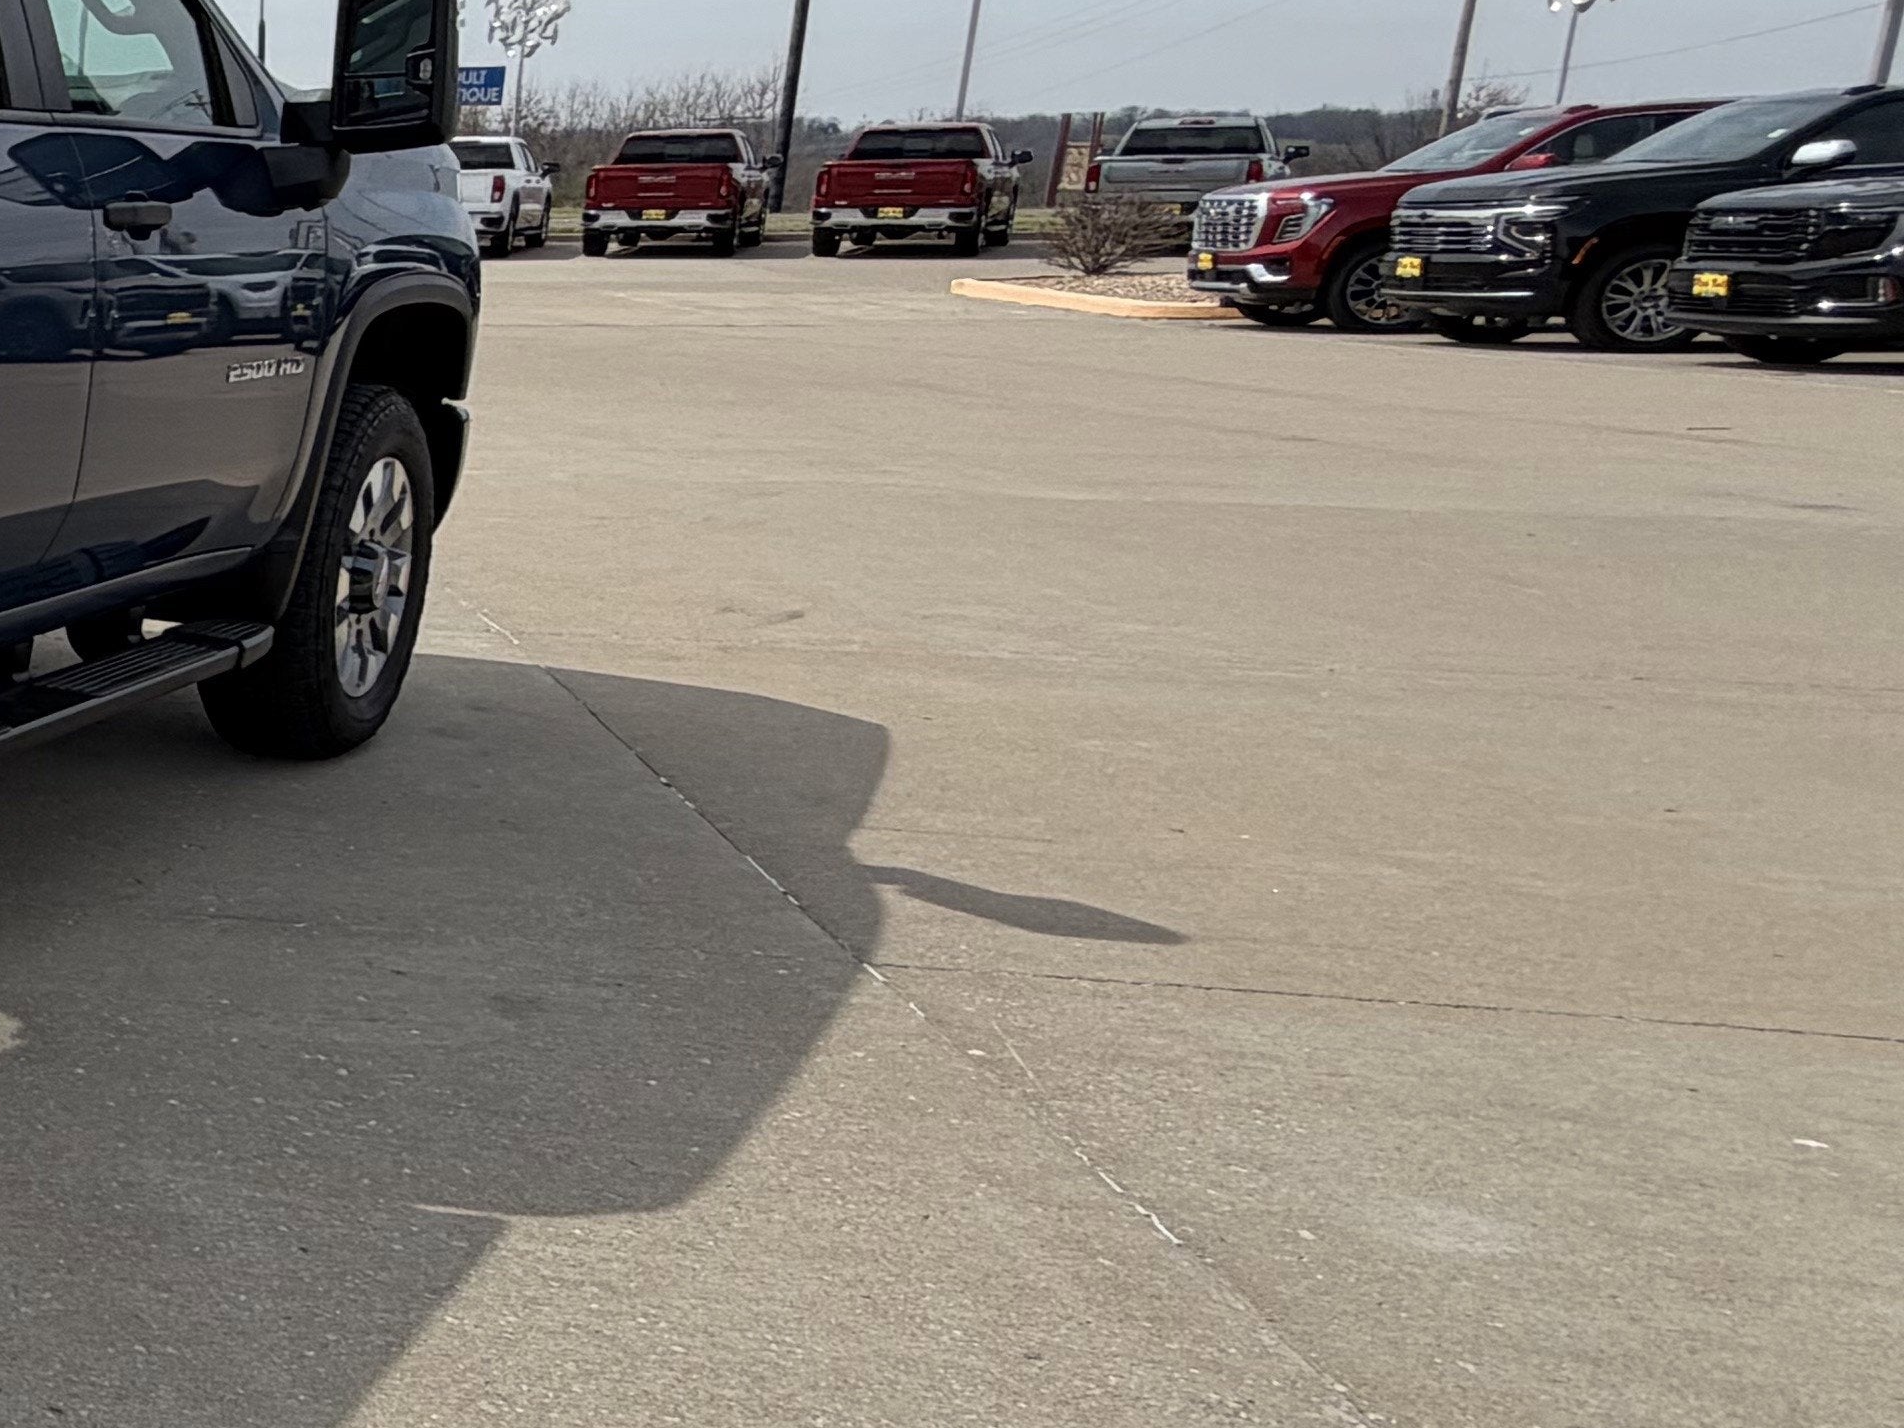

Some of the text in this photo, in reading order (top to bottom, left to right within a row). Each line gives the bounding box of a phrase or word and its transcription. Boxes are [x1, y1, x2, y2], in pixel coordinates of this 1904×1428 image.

[458, 70, 487, 85] ULT
[226, 355, 305, 383] 2500 HD
